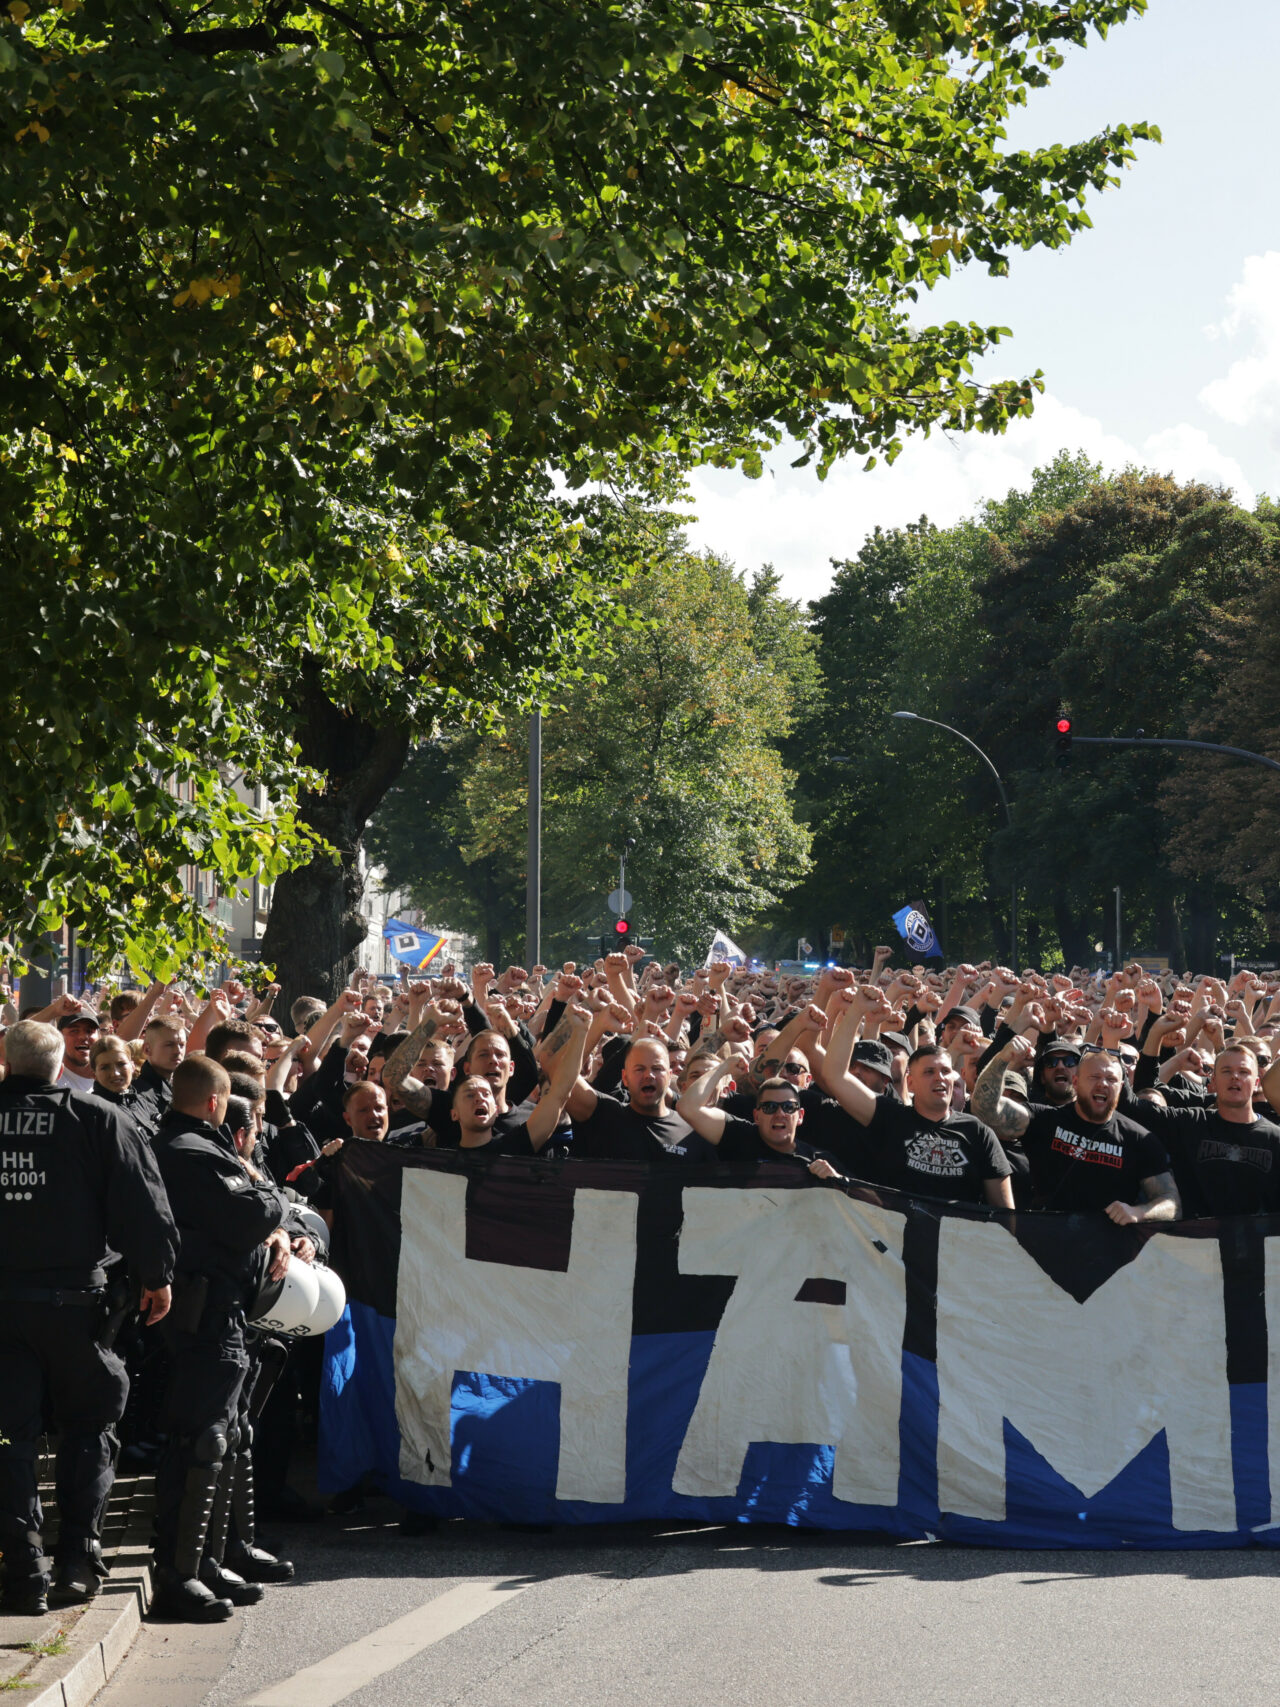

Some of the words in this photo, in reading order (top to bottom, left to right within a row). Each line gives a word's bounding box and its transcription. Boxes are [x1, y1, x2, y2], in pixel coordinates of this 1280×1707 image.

[2, 1151, 34, 1169] HH
[907, 1158, 964, 1176] HOOLIGANS
[0, 1171, 46, 1187] 61001
